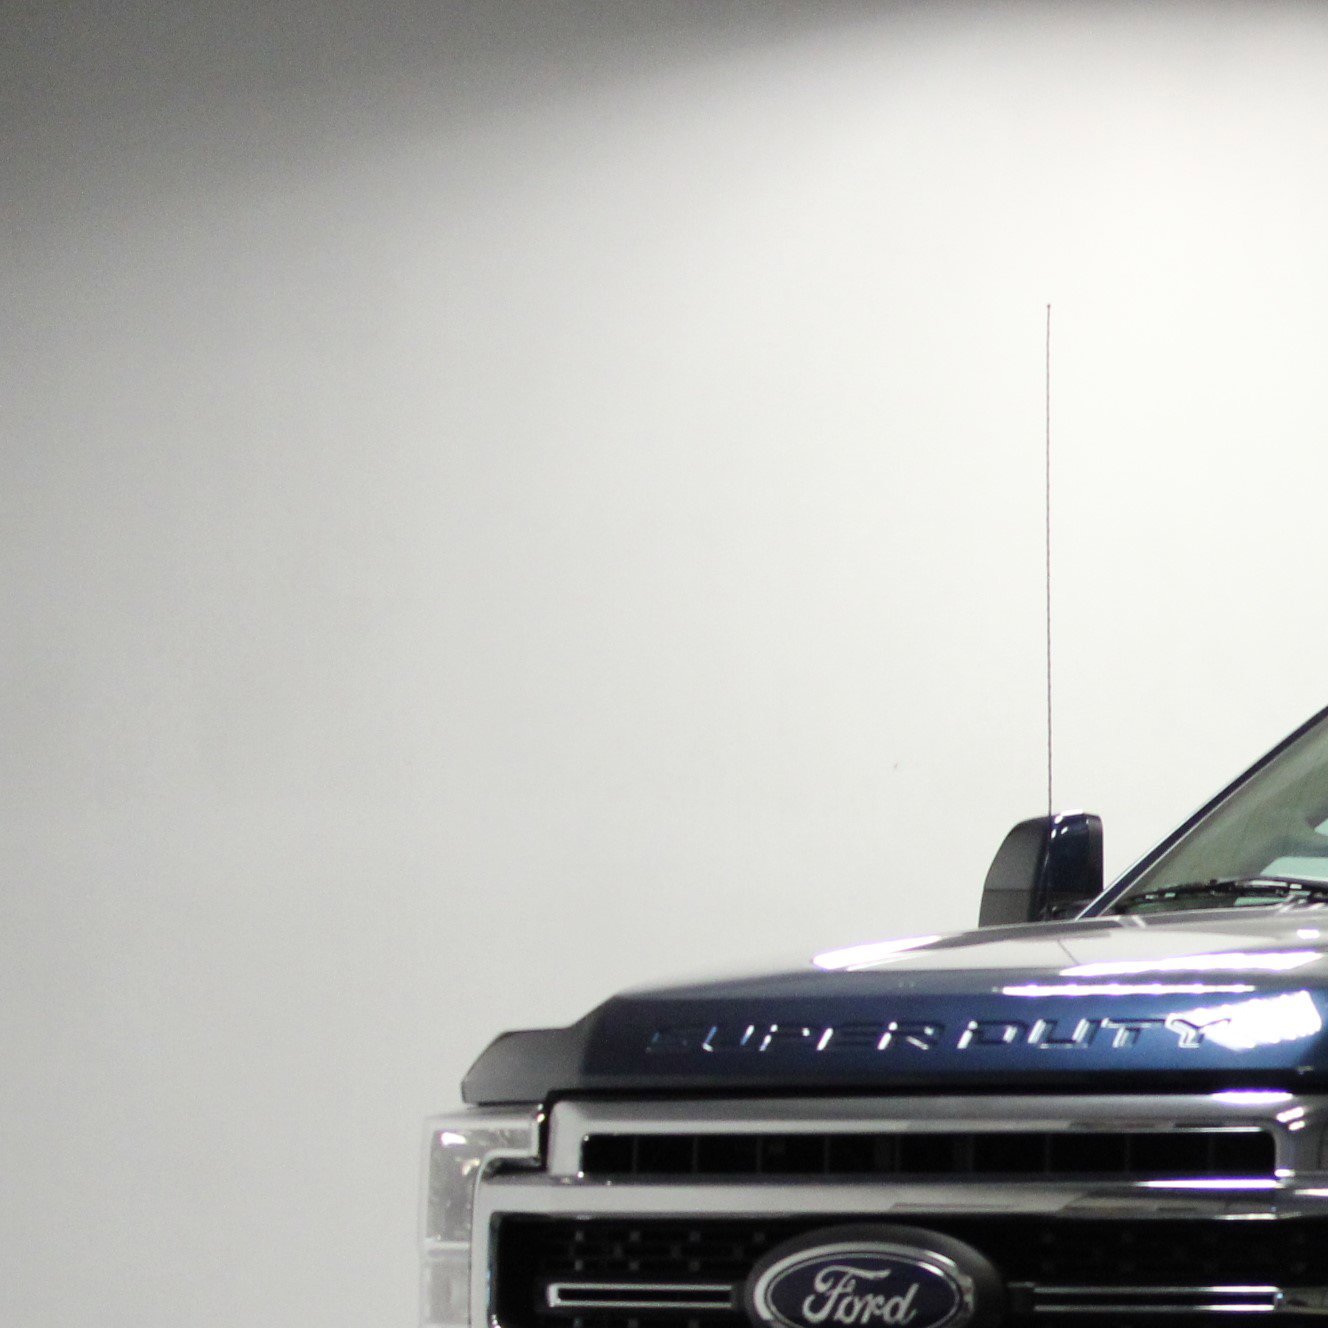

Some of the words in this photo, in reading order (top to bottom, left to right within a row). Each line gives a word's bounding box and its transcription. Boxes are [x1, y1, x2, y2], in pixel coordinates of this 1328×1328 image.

[646, 1020, 946, 1052] SUPER
[955, 1016, 1233, 1050] DUTY
[802, 1264, 920, 1325] Ford
